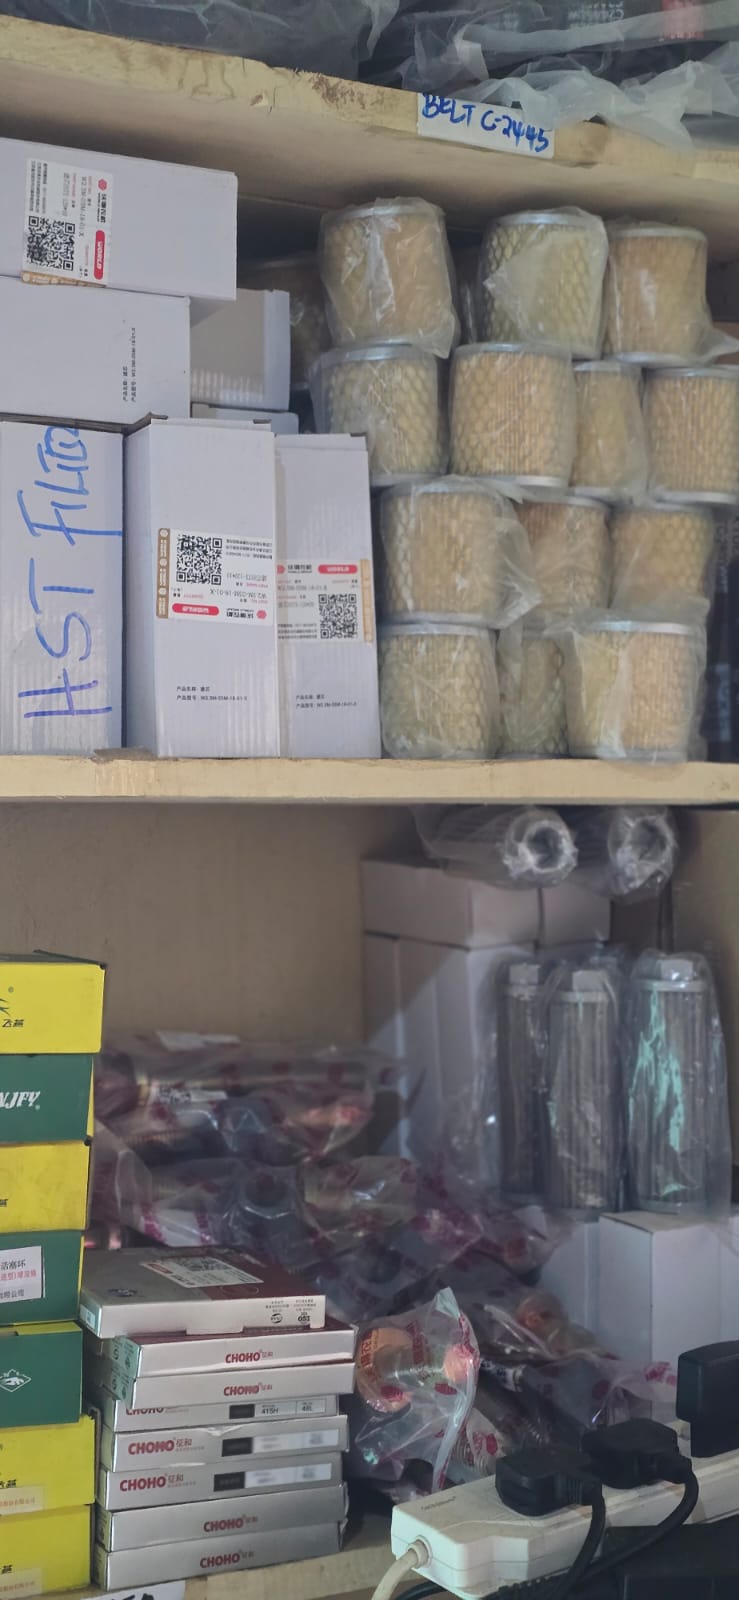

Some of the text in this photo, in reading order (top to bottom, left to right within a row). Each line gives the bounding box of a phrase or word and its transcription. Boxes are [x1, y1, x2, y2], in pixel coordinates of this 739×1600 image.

[422, 92, 476, 127] BELT
[18, 557, 112, 718] HST
[225, 1351, 260, 1363] CHOHO
[223, 1384, 259, 1396] CHOHO
[128, 1440, 174, 1455] CHOHO
[119, 1476, 166, 1492] CHOHO
[203, 1518, 244, 1532] CHOHO
[200, 1553, 240, 1568] CHOHO
